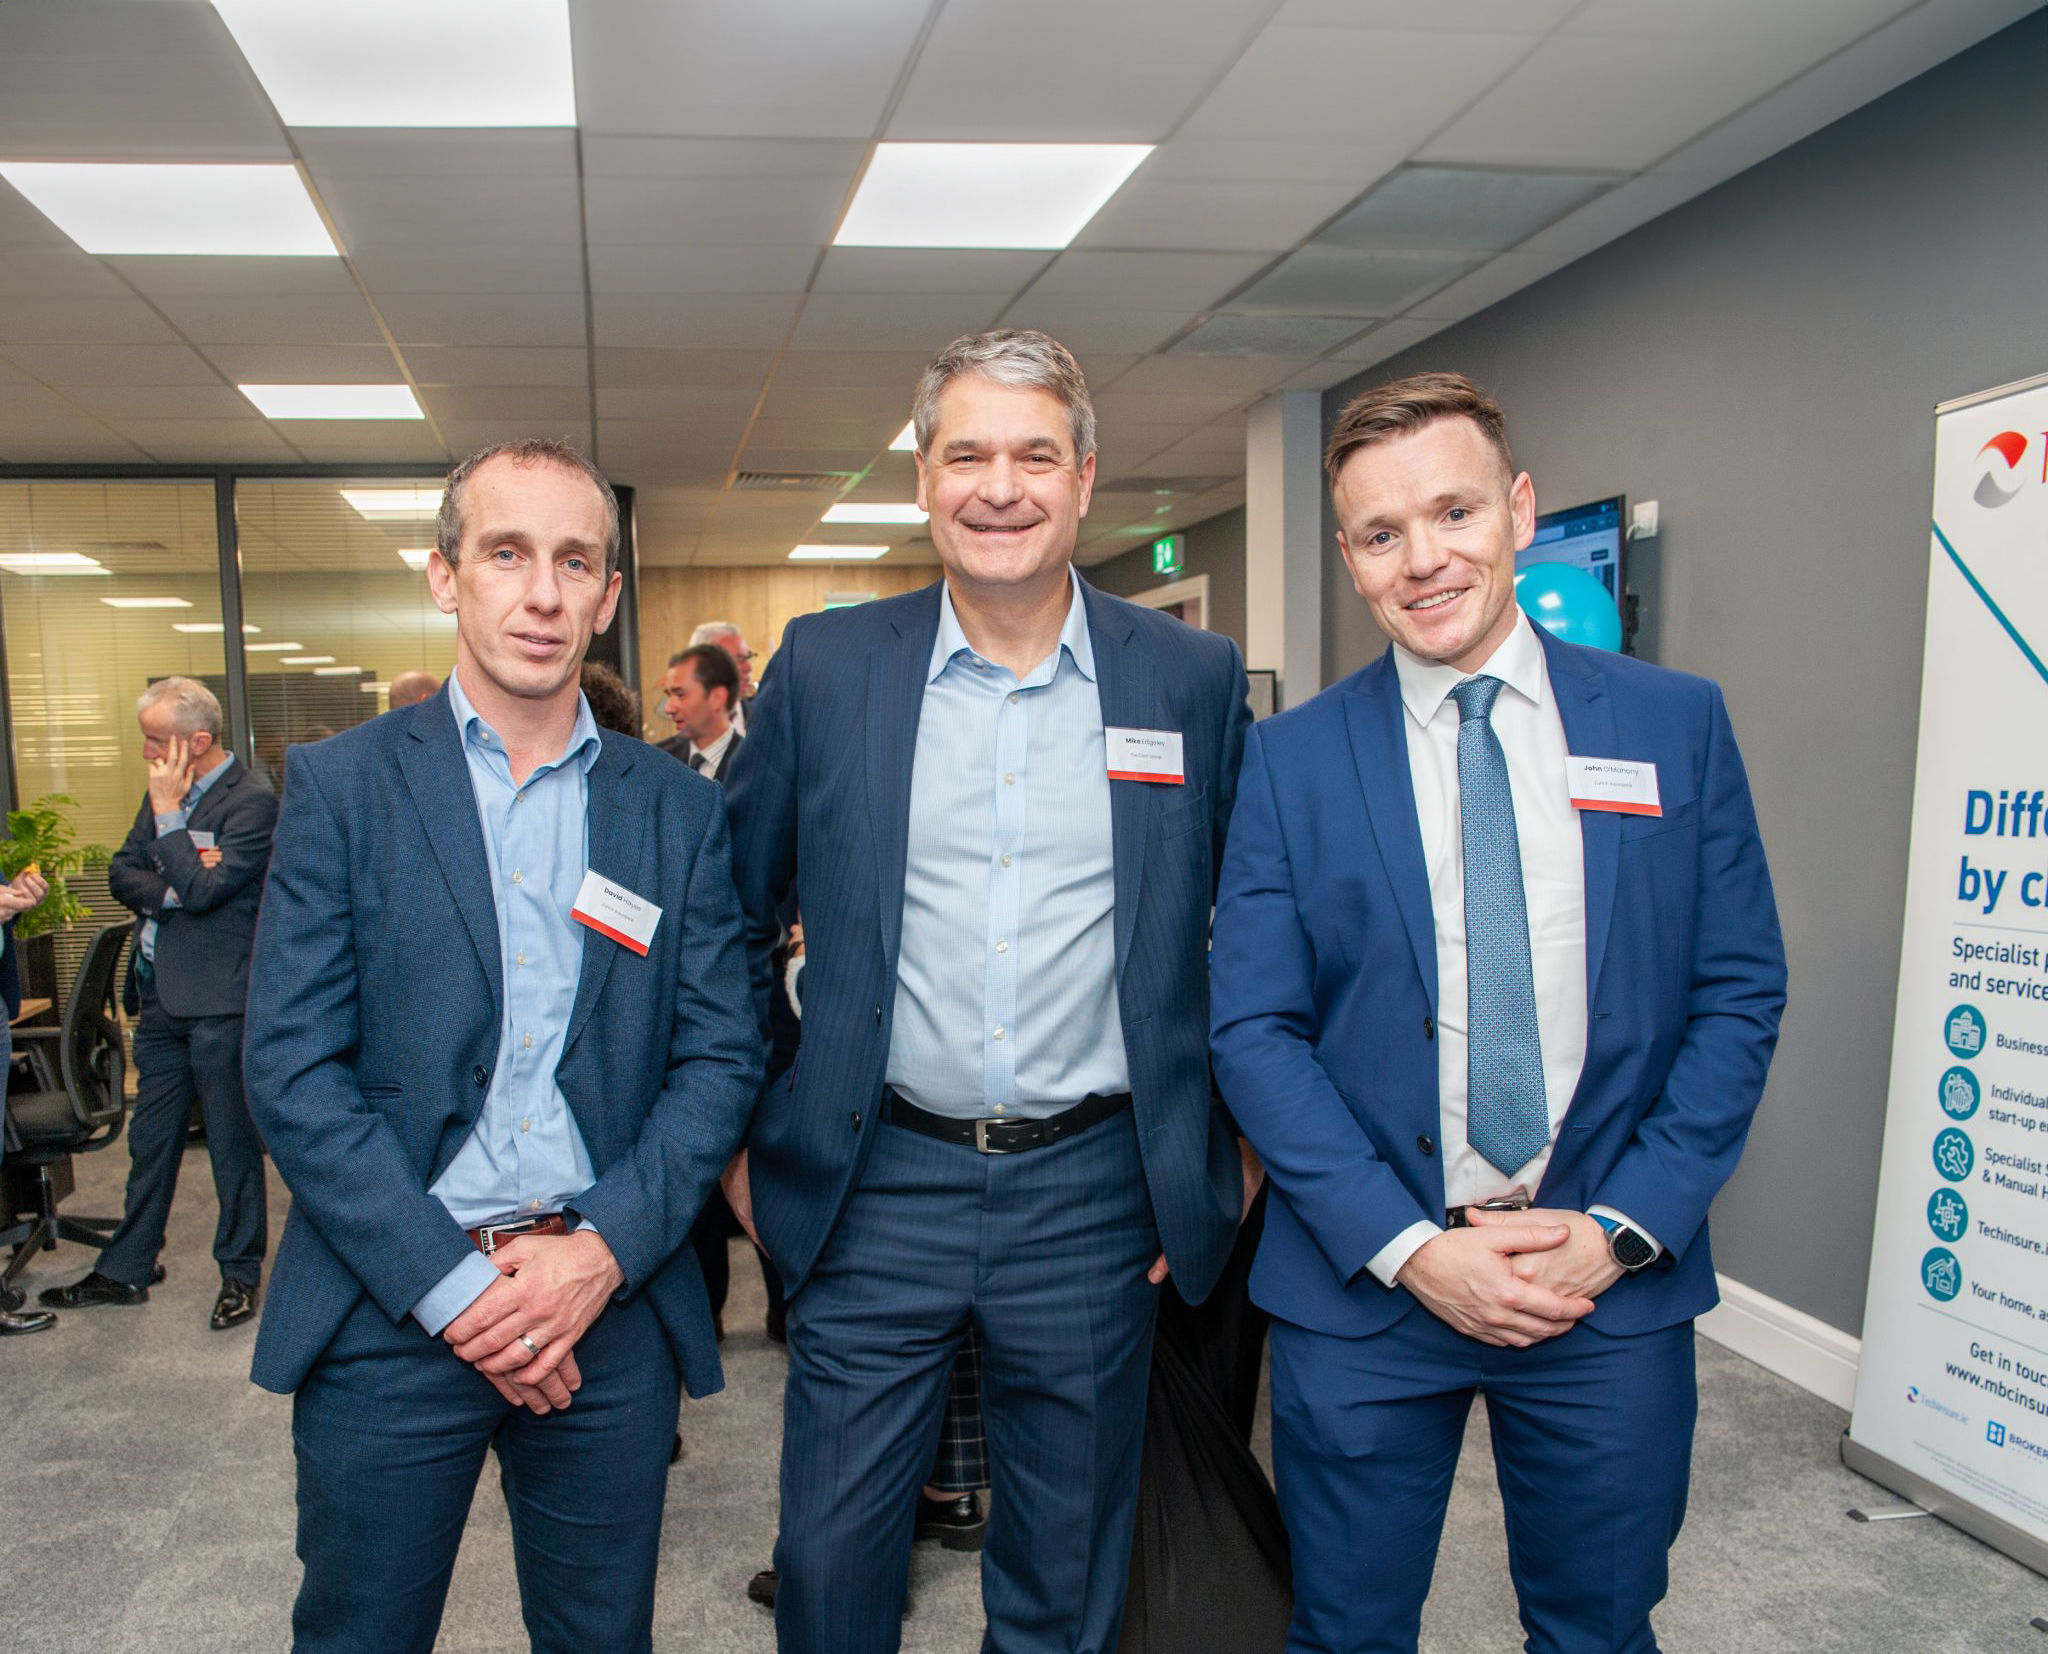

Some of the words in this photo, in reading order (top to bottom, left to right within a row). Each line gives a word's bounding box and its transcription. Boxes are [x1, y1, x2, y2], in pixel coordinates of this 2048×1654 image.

[1125, 737, 1141, 745] Mike
[1964, 790, 2048, 838] Diff
[604, 887, 624, 901] David
[1958, 855, 2008, 916] by
[1952, 937, 2039, 967] Specialist
[1949, 970, 1981, 991] and
[1996, 1033, 2048, 1056] Business
[1988, 1109, 2036, 1132] start-up
[1985, 1147, 2042, 1175] Specialist
[1982, 1168, 1991, 1183] &
[1995, 1172, 2038, 1197] Manual
[1971, 1281, 1997, 1302] Your
[1999, 1292, 2035, 1319] home,
[1970, 1341, 1994, 1365] Get
[1998, 1353, 2011, 1372] in
[2016, 1361, 2048, 1388] touc
